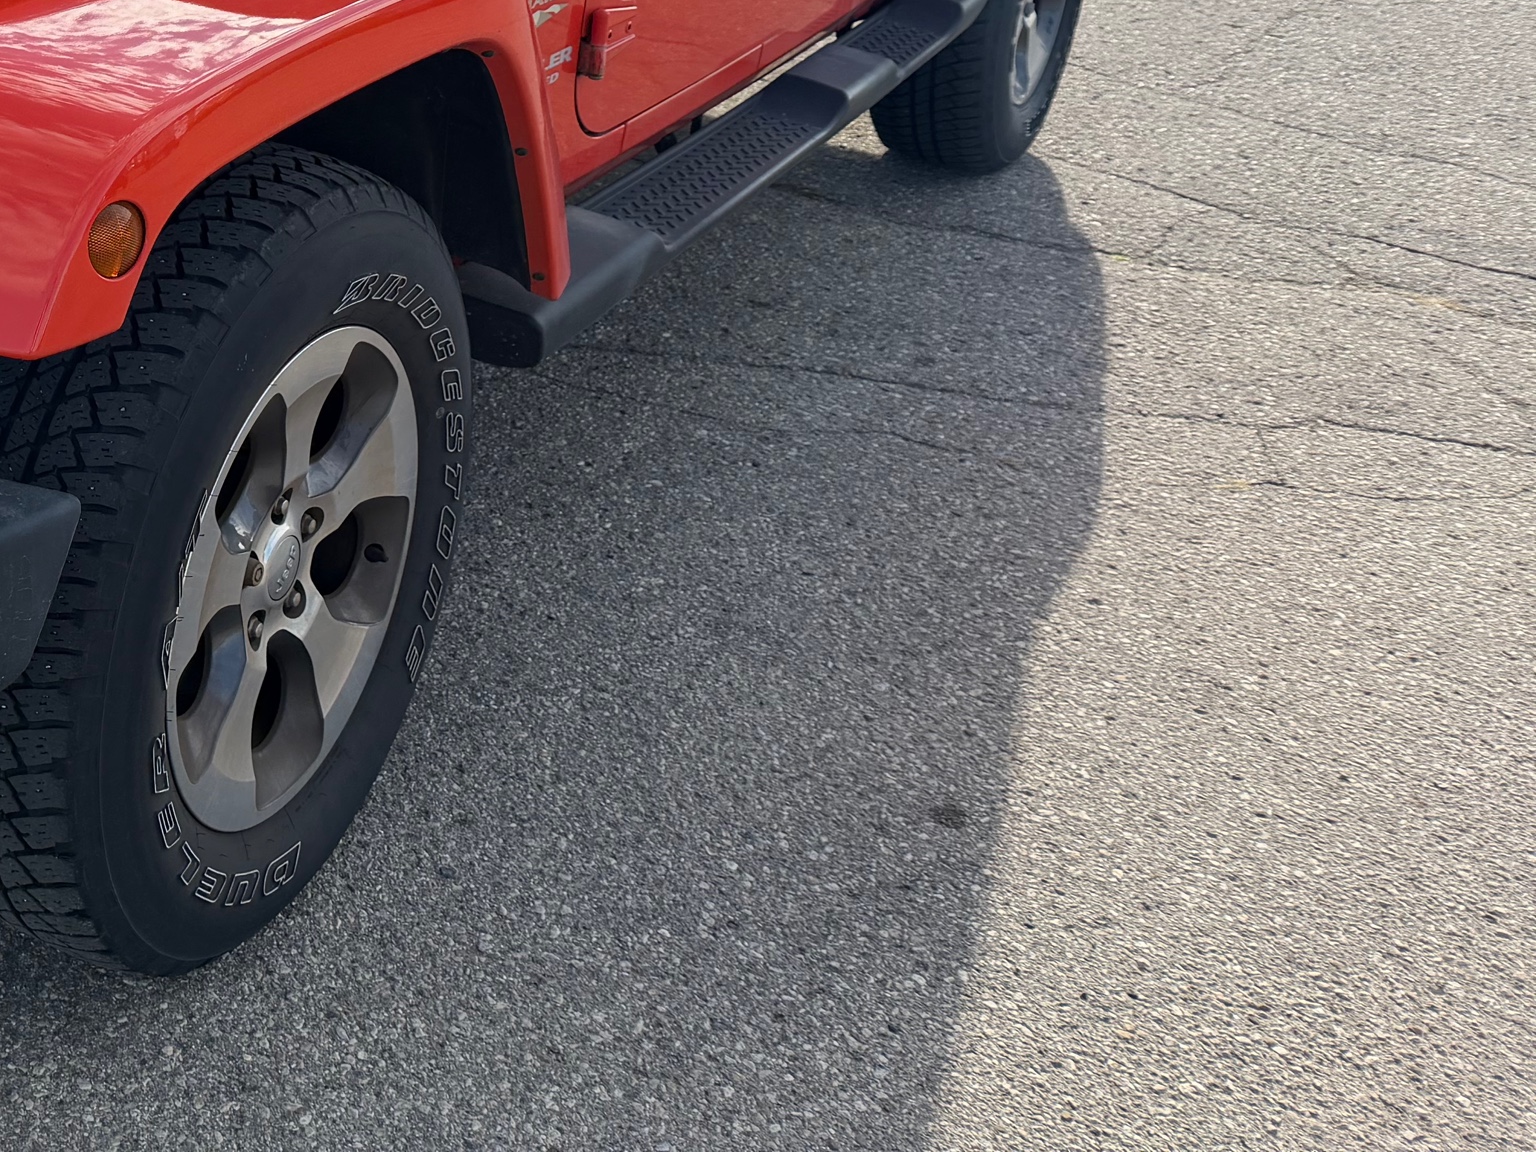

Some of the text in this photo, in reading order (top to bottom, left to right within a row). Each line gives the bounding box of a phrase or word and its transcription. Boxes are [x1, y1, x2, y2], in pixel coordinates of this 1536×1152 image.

[332, 273, 464, 683] BRIDGESTONE
[275, 544, 297, 594] Jeep
[152, 732, 302, 907] DUELER
